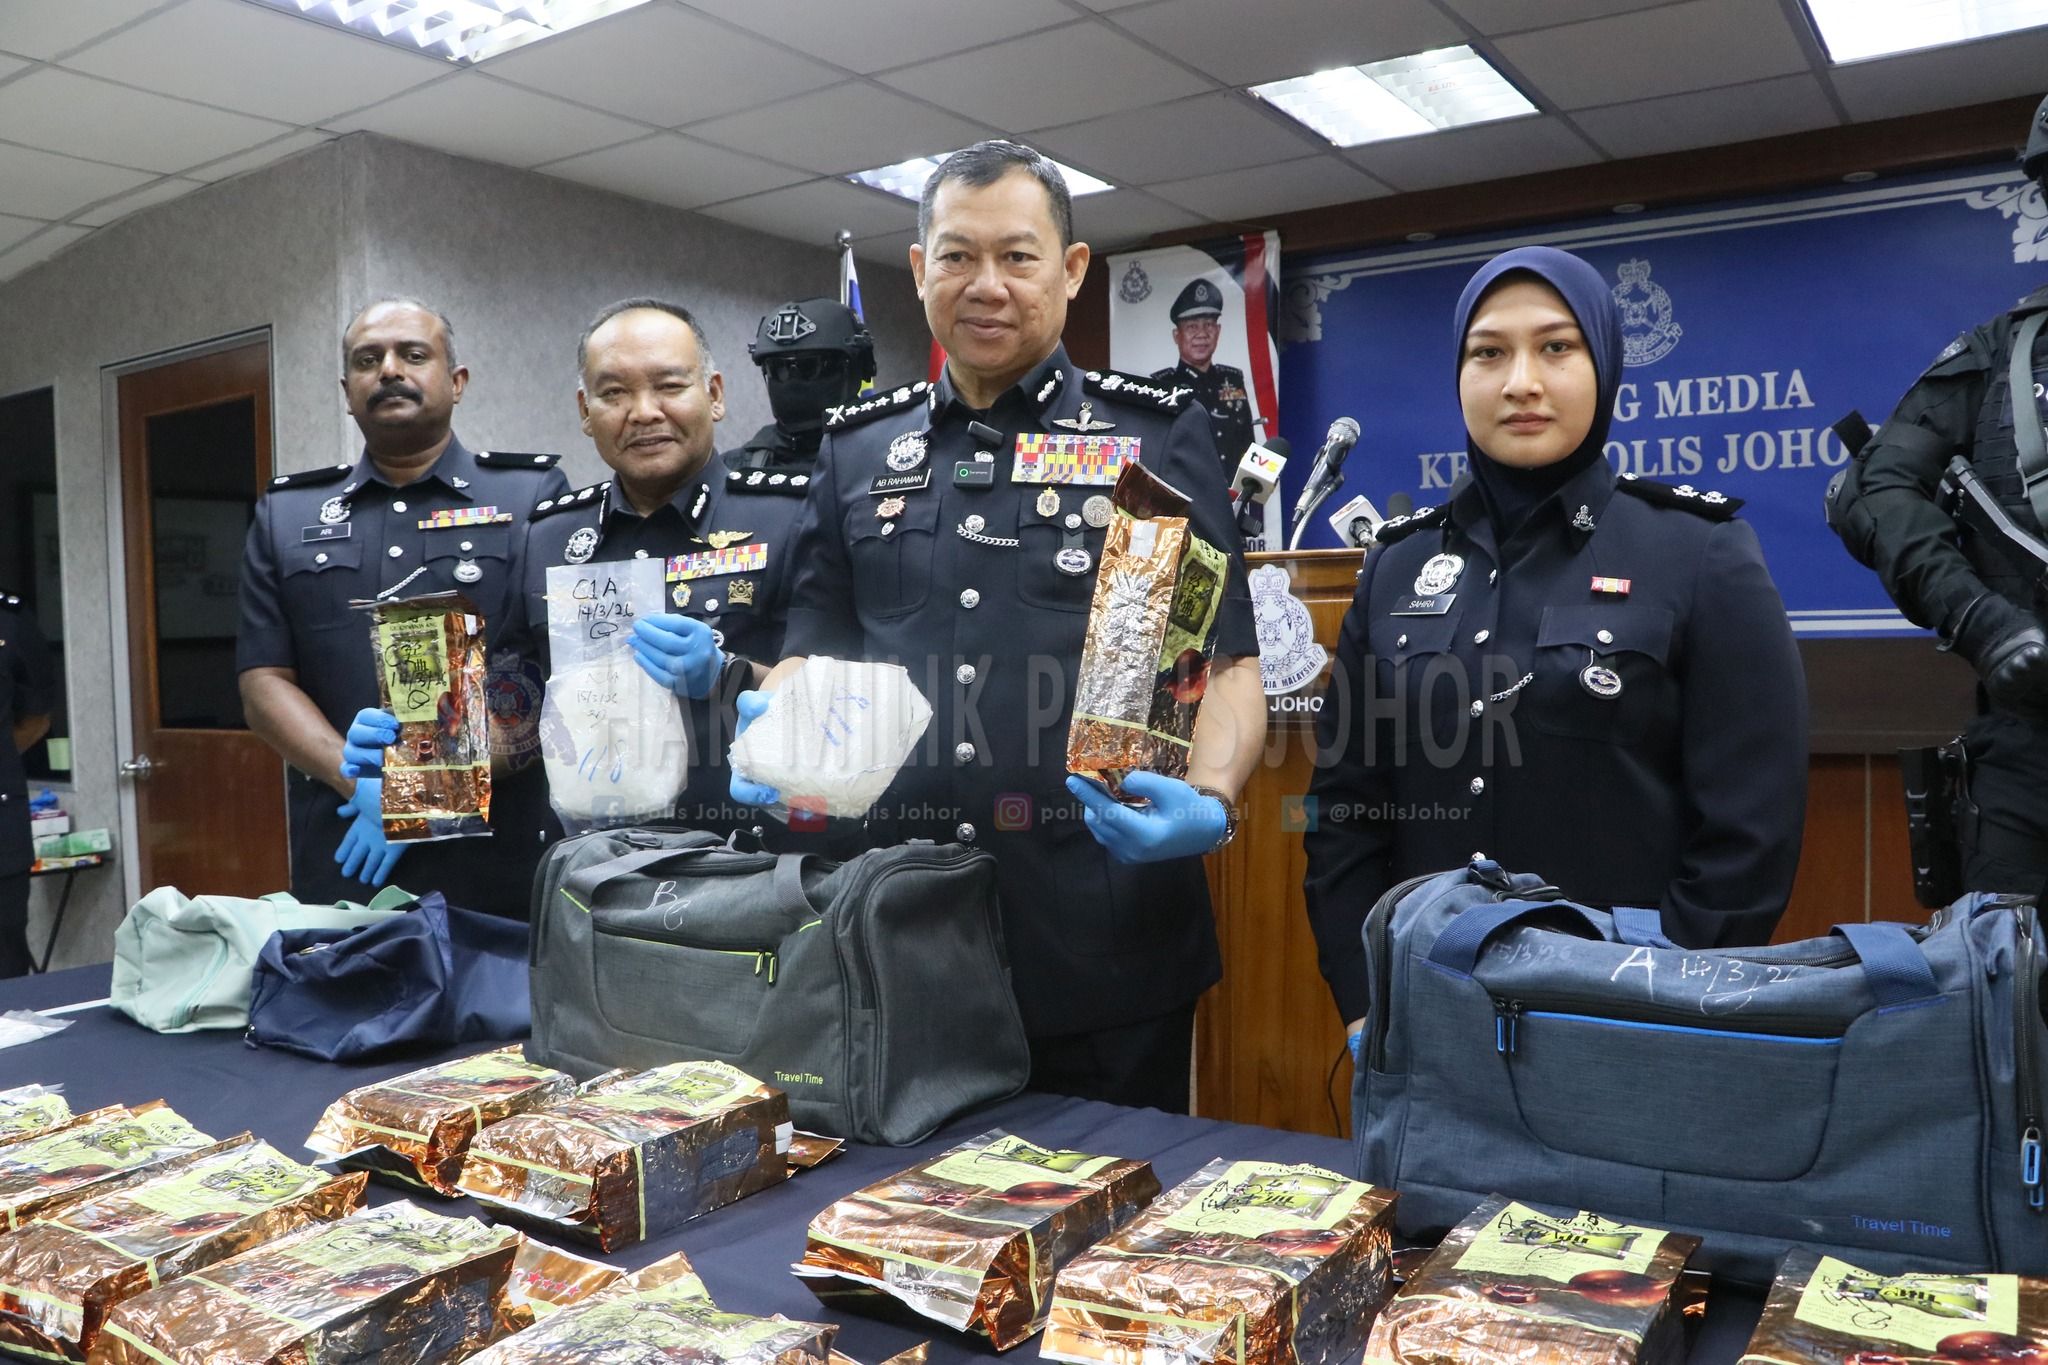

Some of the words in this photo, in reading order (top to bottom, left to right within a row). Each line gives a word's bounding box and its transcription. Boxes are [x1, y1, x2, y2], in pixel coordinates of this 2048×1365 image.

[1613, 383, 1642, 422] G
[1654, 368, 1815, 419] MEDIA
[1418, 451, 1469, 489] KE
[1601, 436, 1703, 477] OLIS
[875, 479, 886, 487] AB
[887, 474, 924, 486] RAHAMAN
[577, 602, 635, 621] 14/3/26
[1408, 599, 1435, 609] SAHIRA
[1263, 680, 1278, 689] AJA
[1281, 660, 1317, 688] MALAYSIA
[1269, 696, 1325, 712] JOHO
[1610, 946, 1657, 1001] A
[774, 1071, 803, 1083] Travel
[804, 1073, 824, 1085] Time
[1850, 1214, 1905, 1233] Travel
[1909, 1220, 1953, 1237] Time
